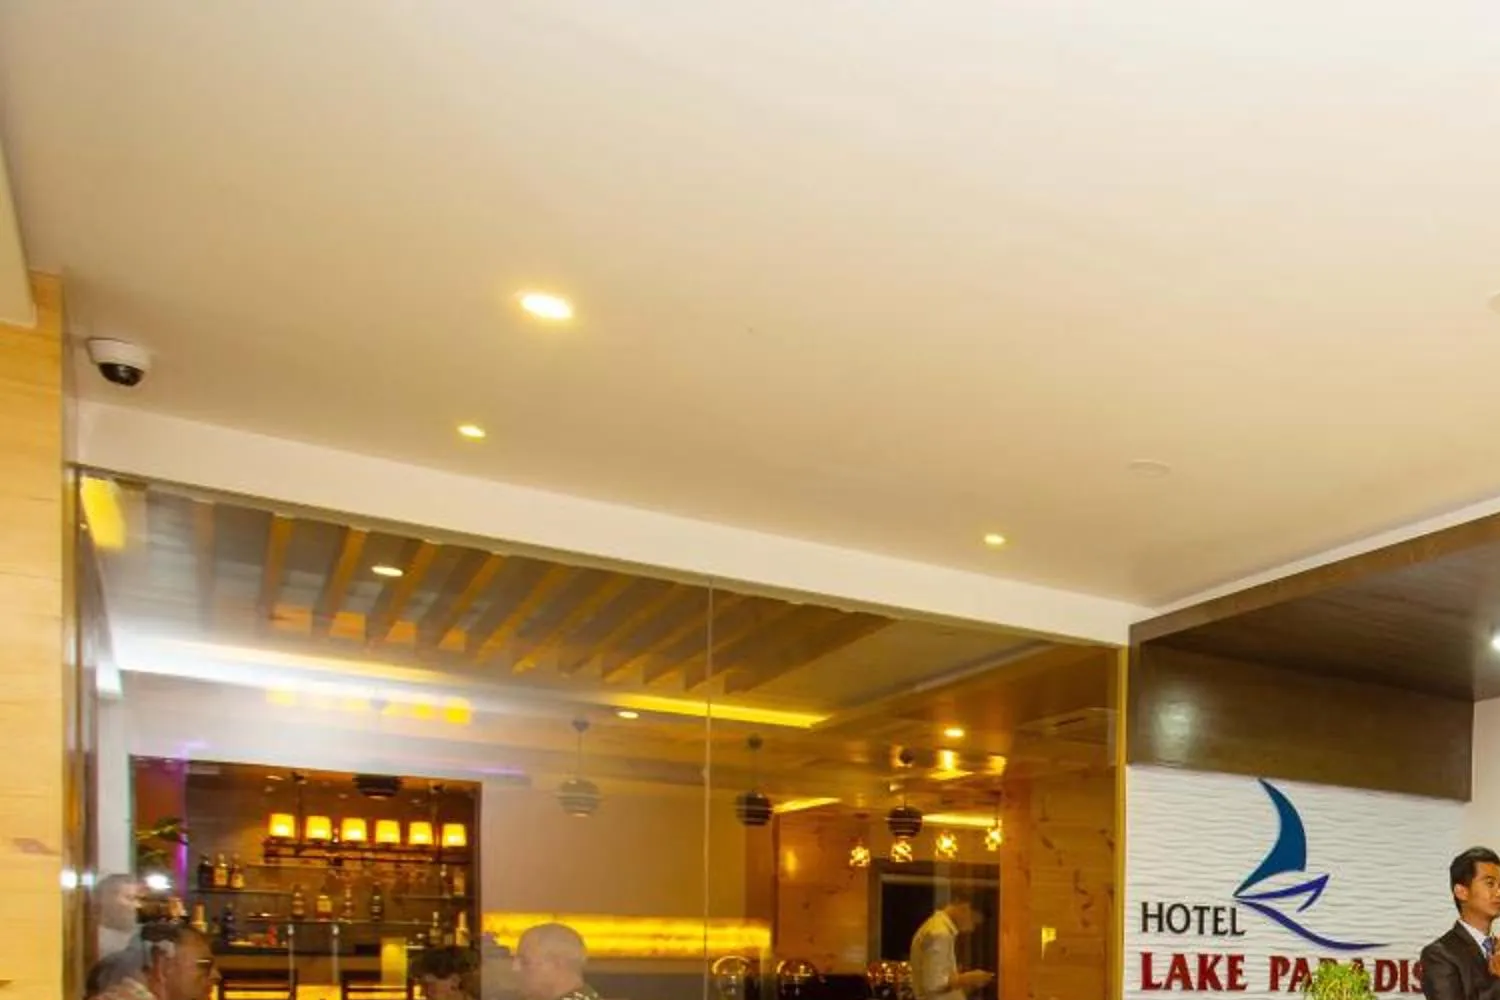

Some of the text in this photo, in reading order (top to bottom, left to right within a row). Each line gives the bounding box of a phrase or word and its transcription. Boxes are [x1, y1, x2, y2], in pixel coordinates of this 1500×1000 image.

[1140, 902, 1245, 936] HOTEL
[1140, 952, 1425, 993] LAKE PADIS
